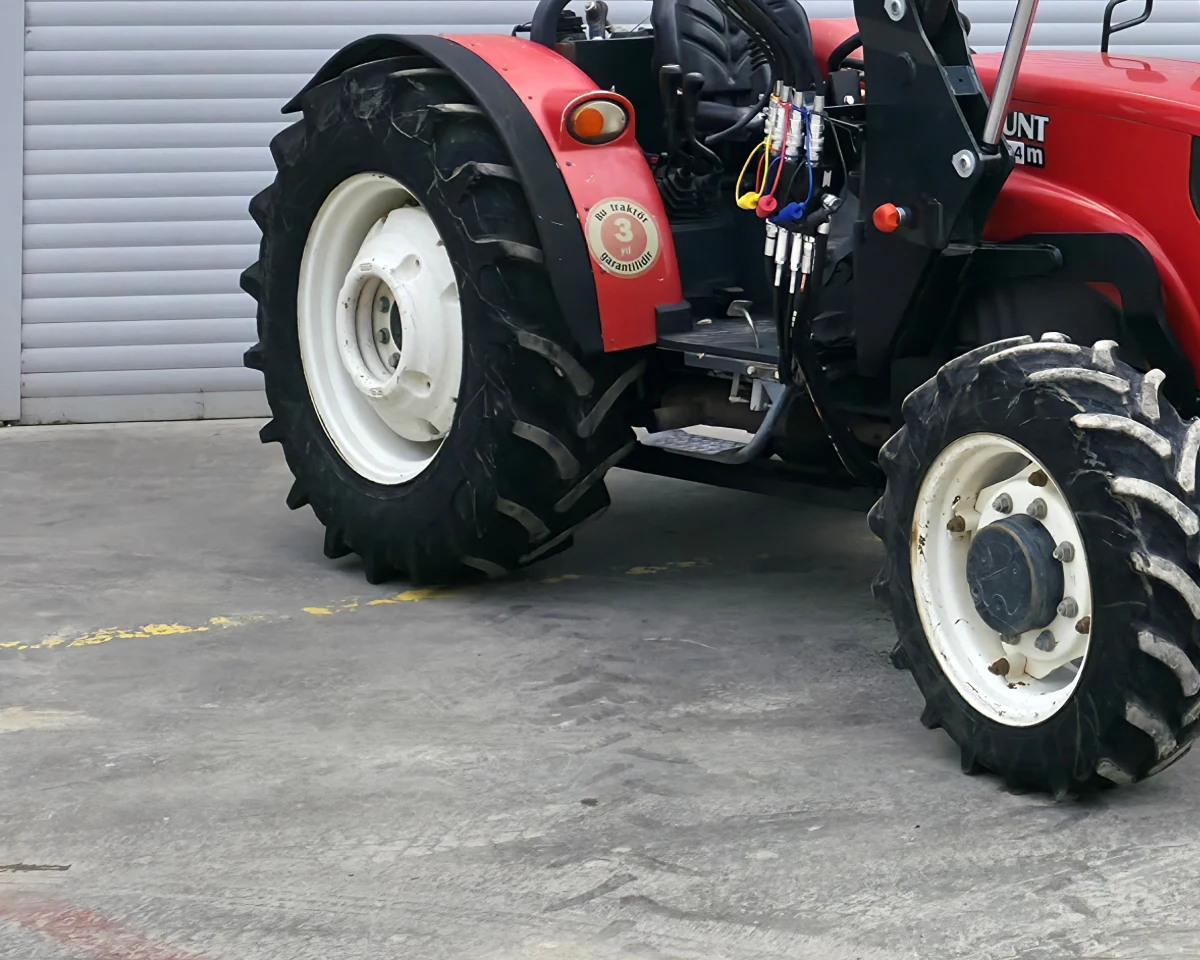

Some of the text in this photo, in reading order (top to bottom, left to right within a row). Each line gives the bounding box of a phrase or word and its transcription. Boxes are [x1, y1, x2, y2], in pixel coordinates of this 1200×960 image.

[1008, 144, 1044, 165] 4m
[610, 204, 648, 223] traktör
[613, 217, 634, 243] 3
[600, 251, 653, 272] garantilidir
